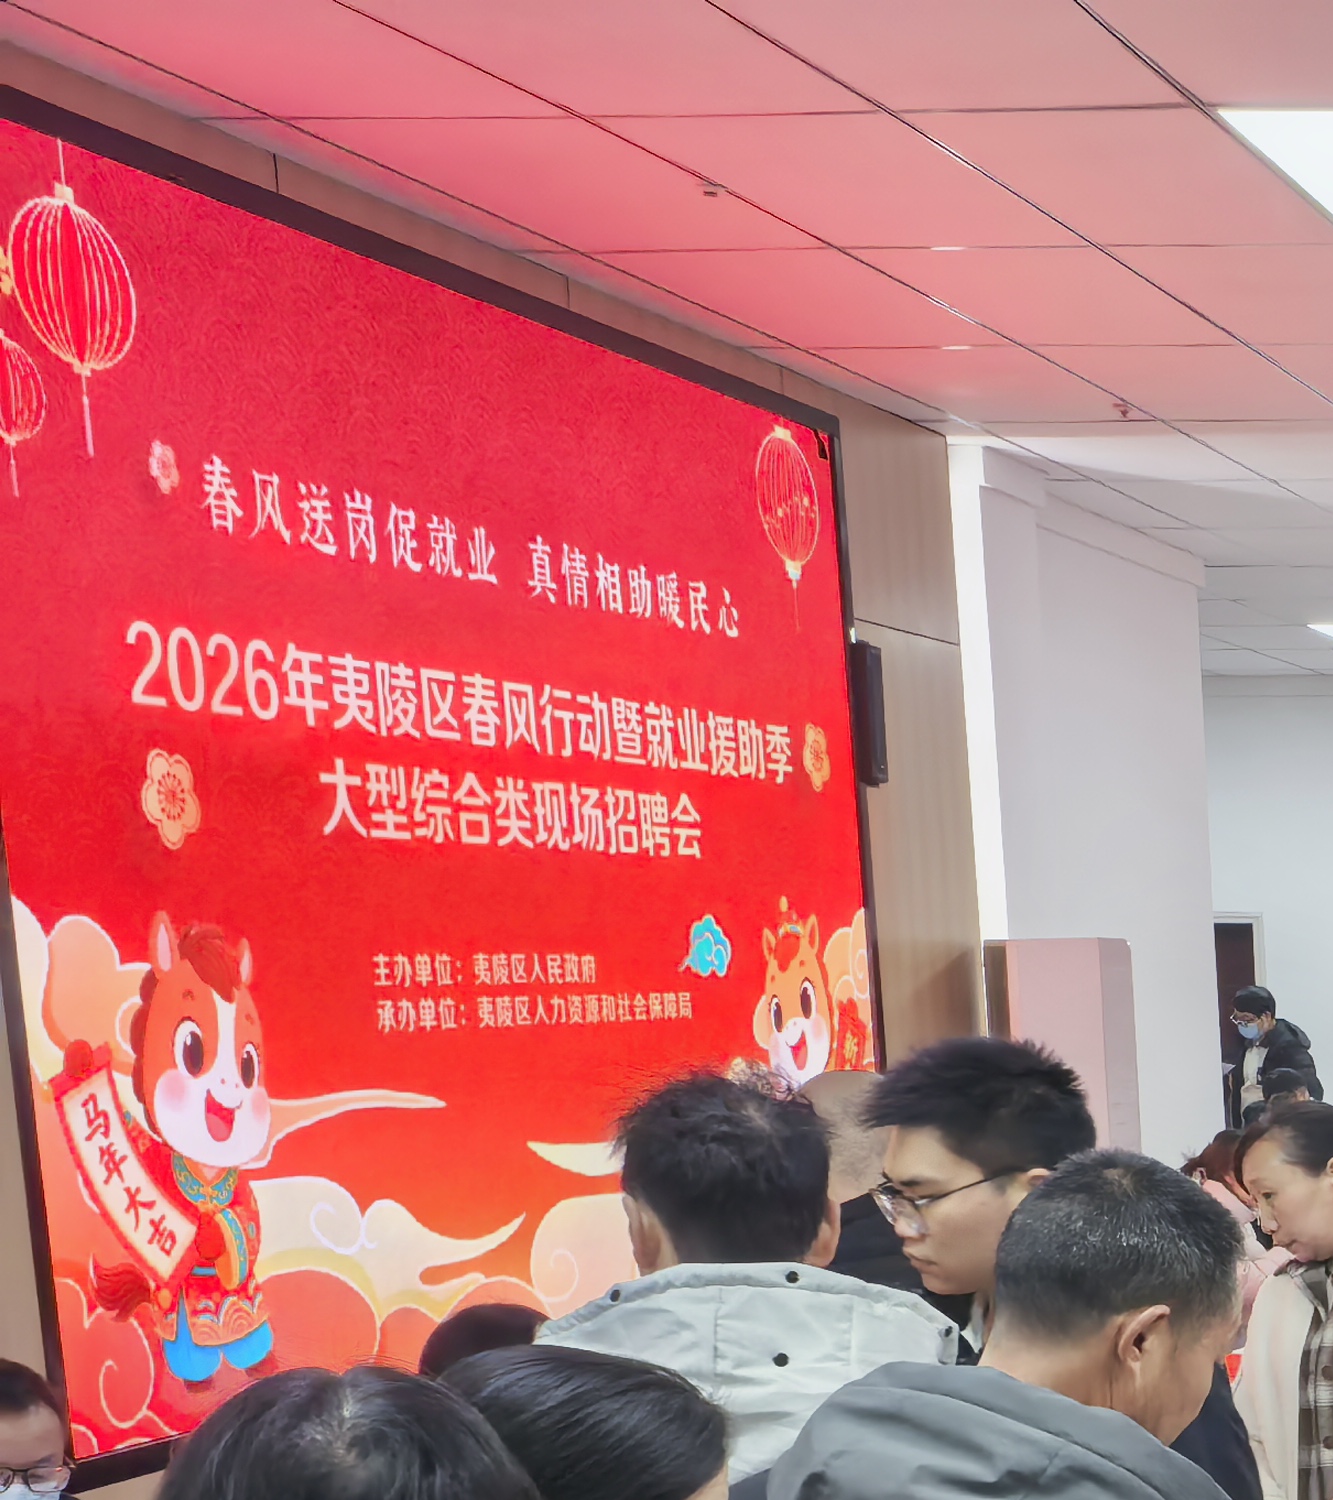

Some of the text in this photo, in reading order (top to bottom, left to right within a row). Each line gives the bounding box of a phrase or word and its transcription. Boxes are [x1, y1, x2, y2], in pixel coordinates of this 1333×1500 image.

[199, 456, 741, 639] 春风送岗促就业 真情相助暖民心
[125, 621, 794, 785] 2026年夷陵区春风行动暨就业援助季
[319, 758, 703, 860] 大型综合类现场招聘会
[373, 953, 596, 987] 主办单位：夷陵区人民政府
[377, 992, 693, 1033] 承办单位：夷陵区人力资源和社会保障局
[81, 1093, 178, 1257] 马年大吉
